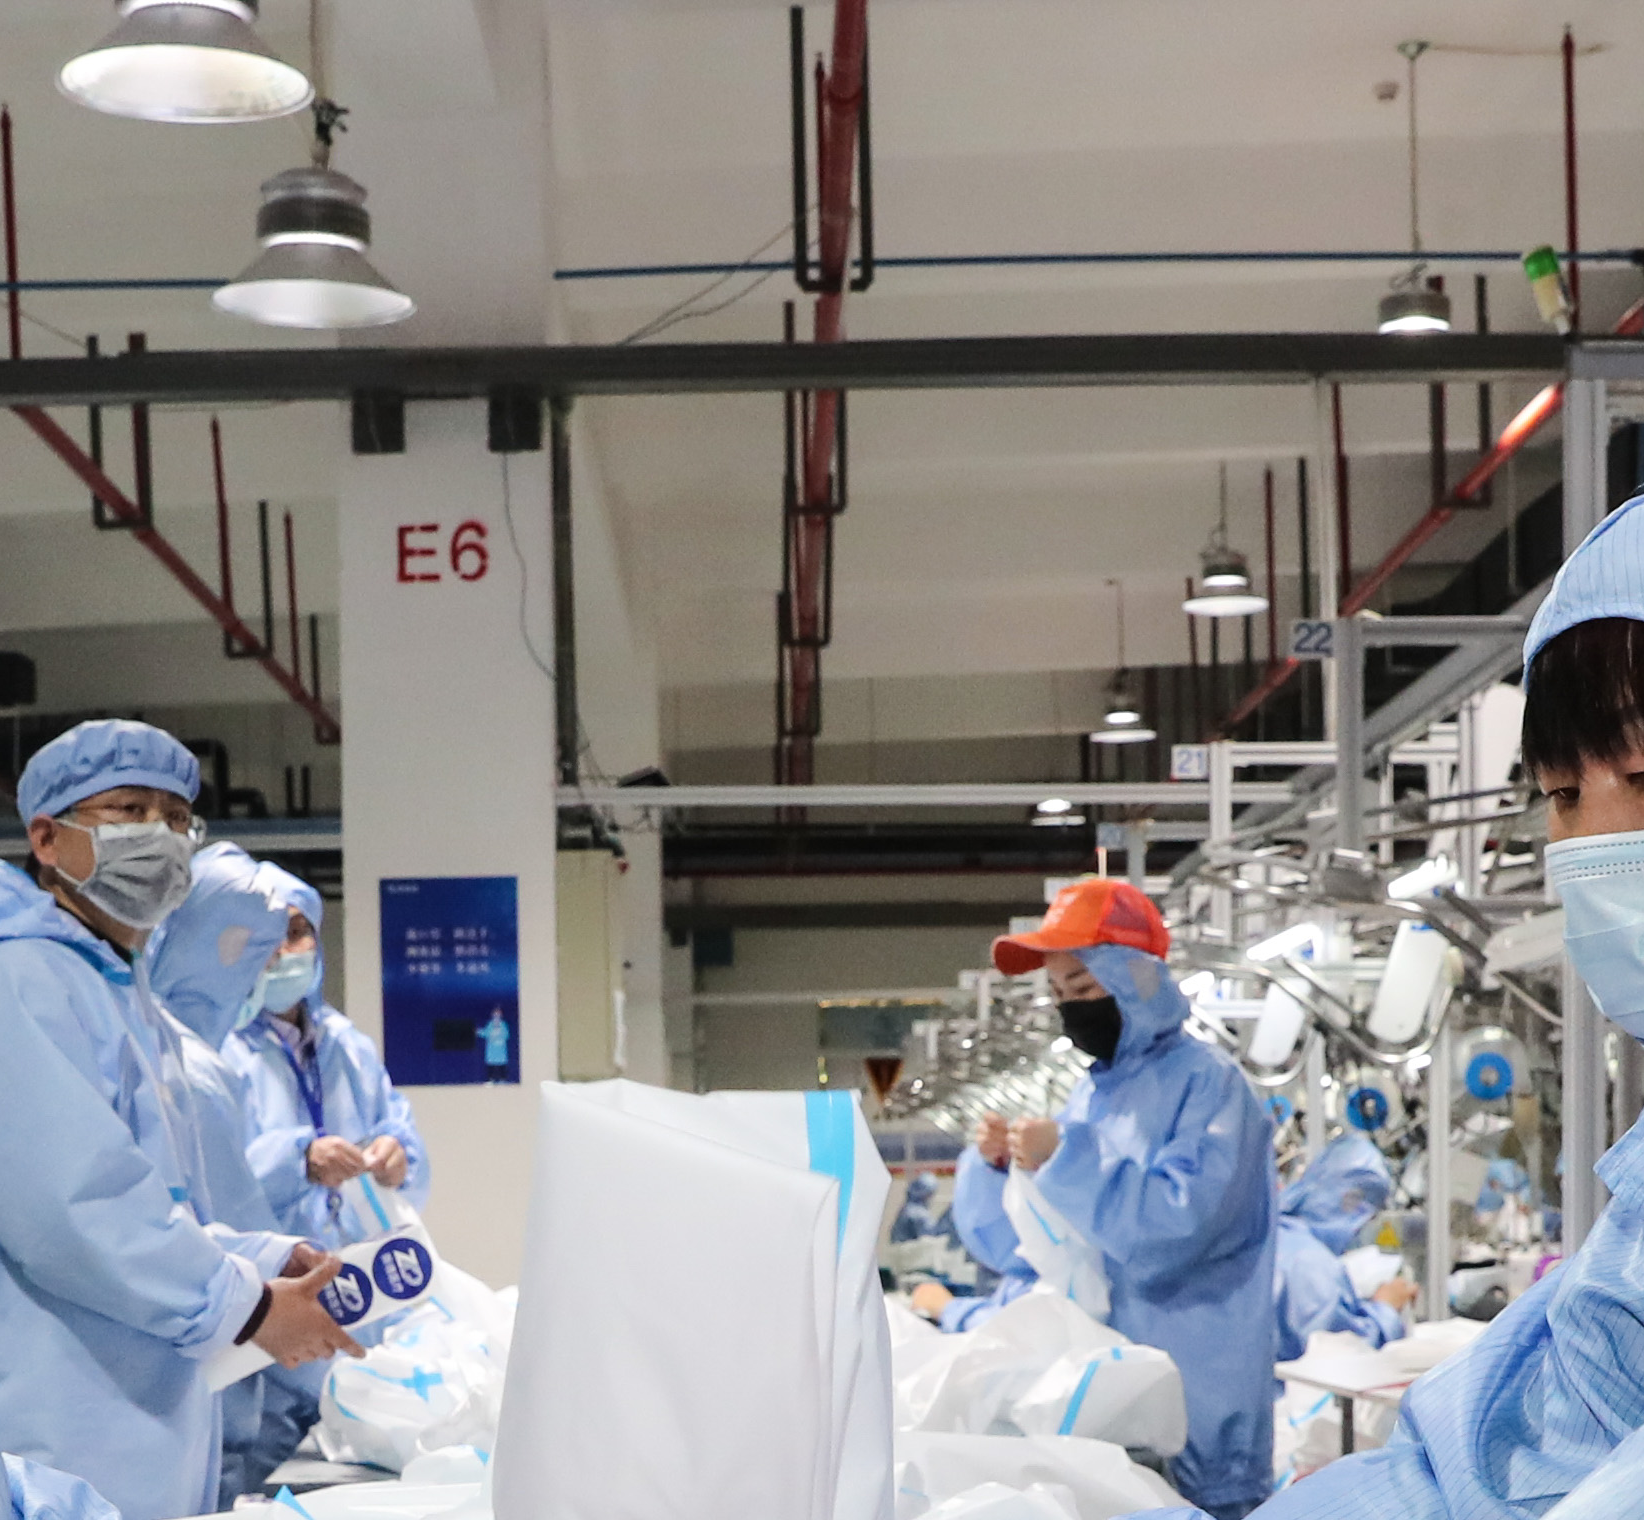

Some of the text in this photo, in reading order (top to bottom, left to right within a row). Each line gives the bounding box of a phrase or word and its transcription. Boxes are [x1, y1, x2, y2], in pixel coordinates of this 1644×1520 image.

[397, 520, 489, 583] E6
[1293, 621, 1334, 655] 22
[1176, 748, 1206, 774] 21
